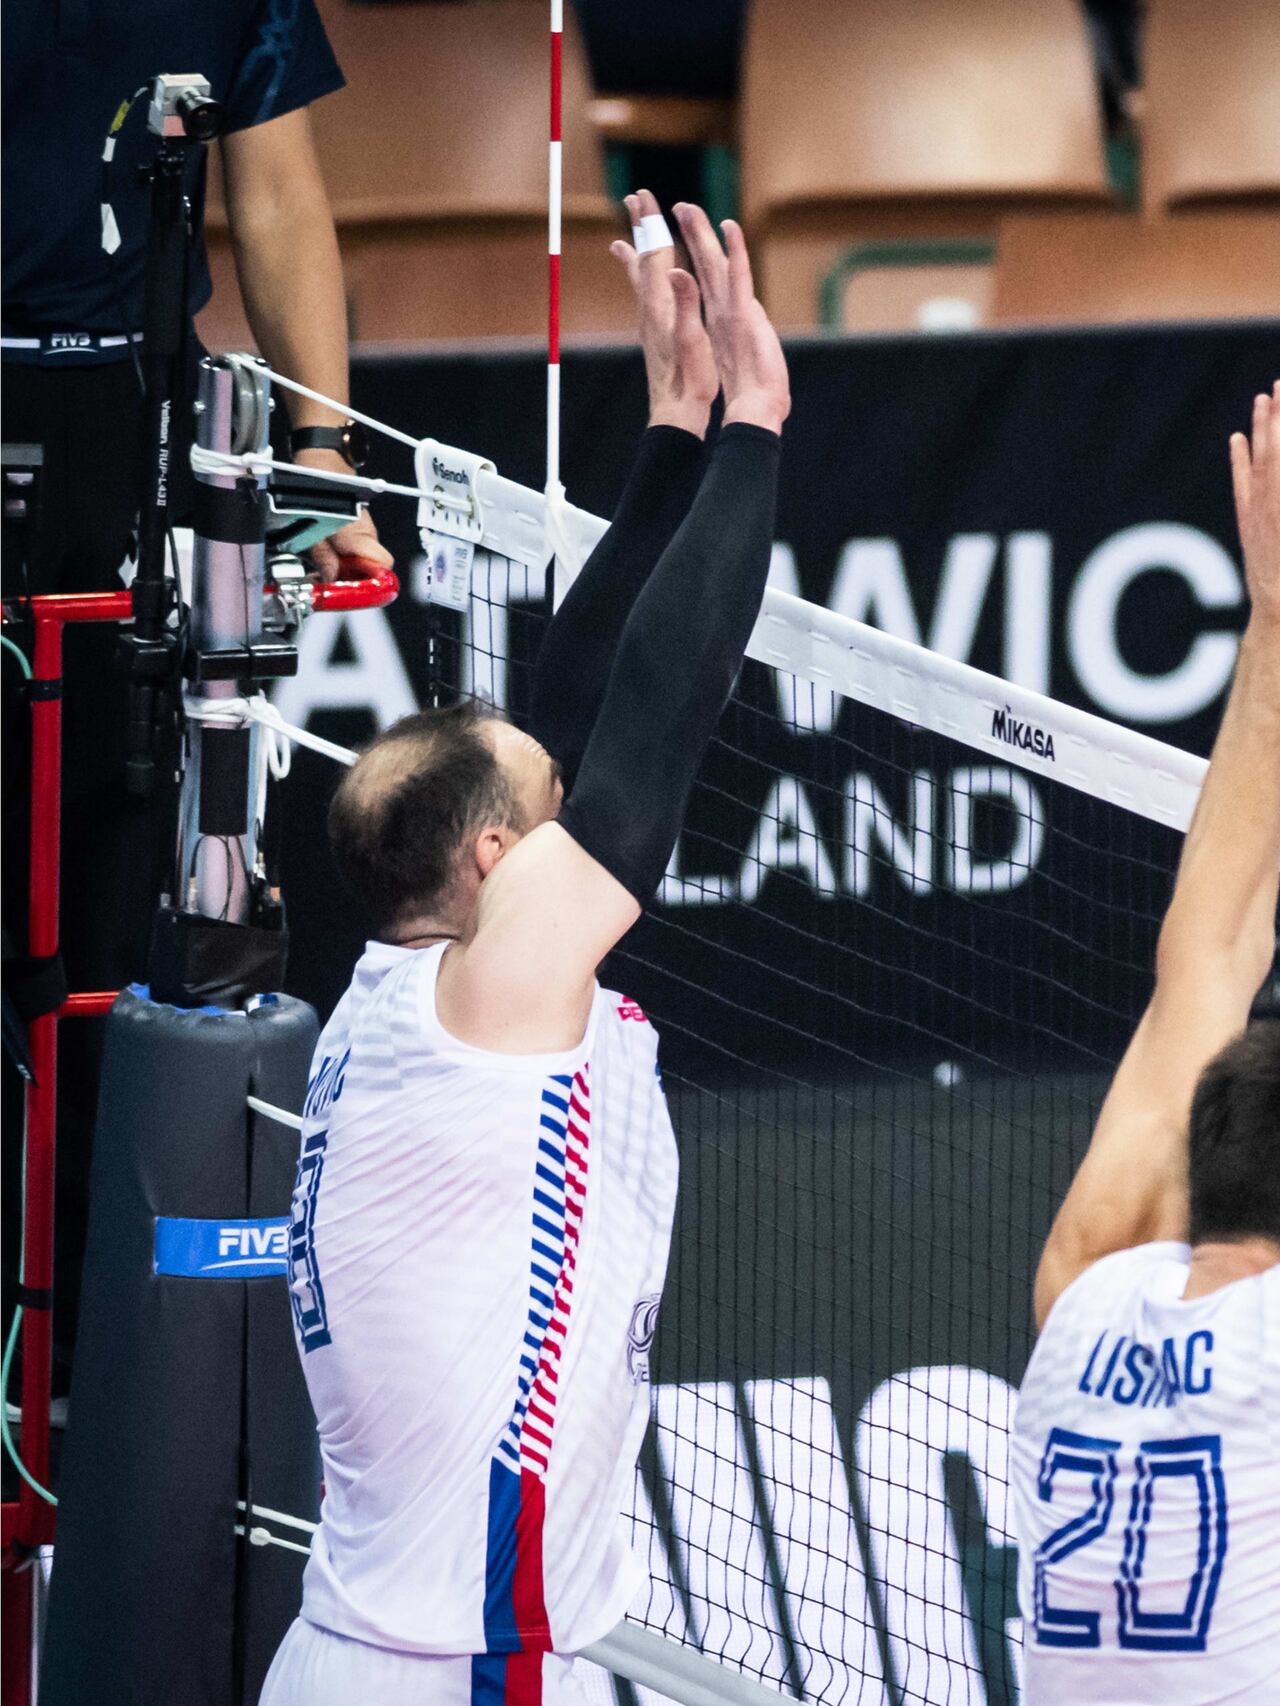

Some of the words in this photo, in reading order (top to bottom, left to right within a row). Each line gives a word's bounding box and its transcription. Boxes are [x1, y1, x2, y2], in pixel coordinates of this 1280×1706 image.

[438, 462, 470, 486] Senoh
[991, 703, 1056, 762] MIKASA
[1034, 1427, 1229, 1655] 20
